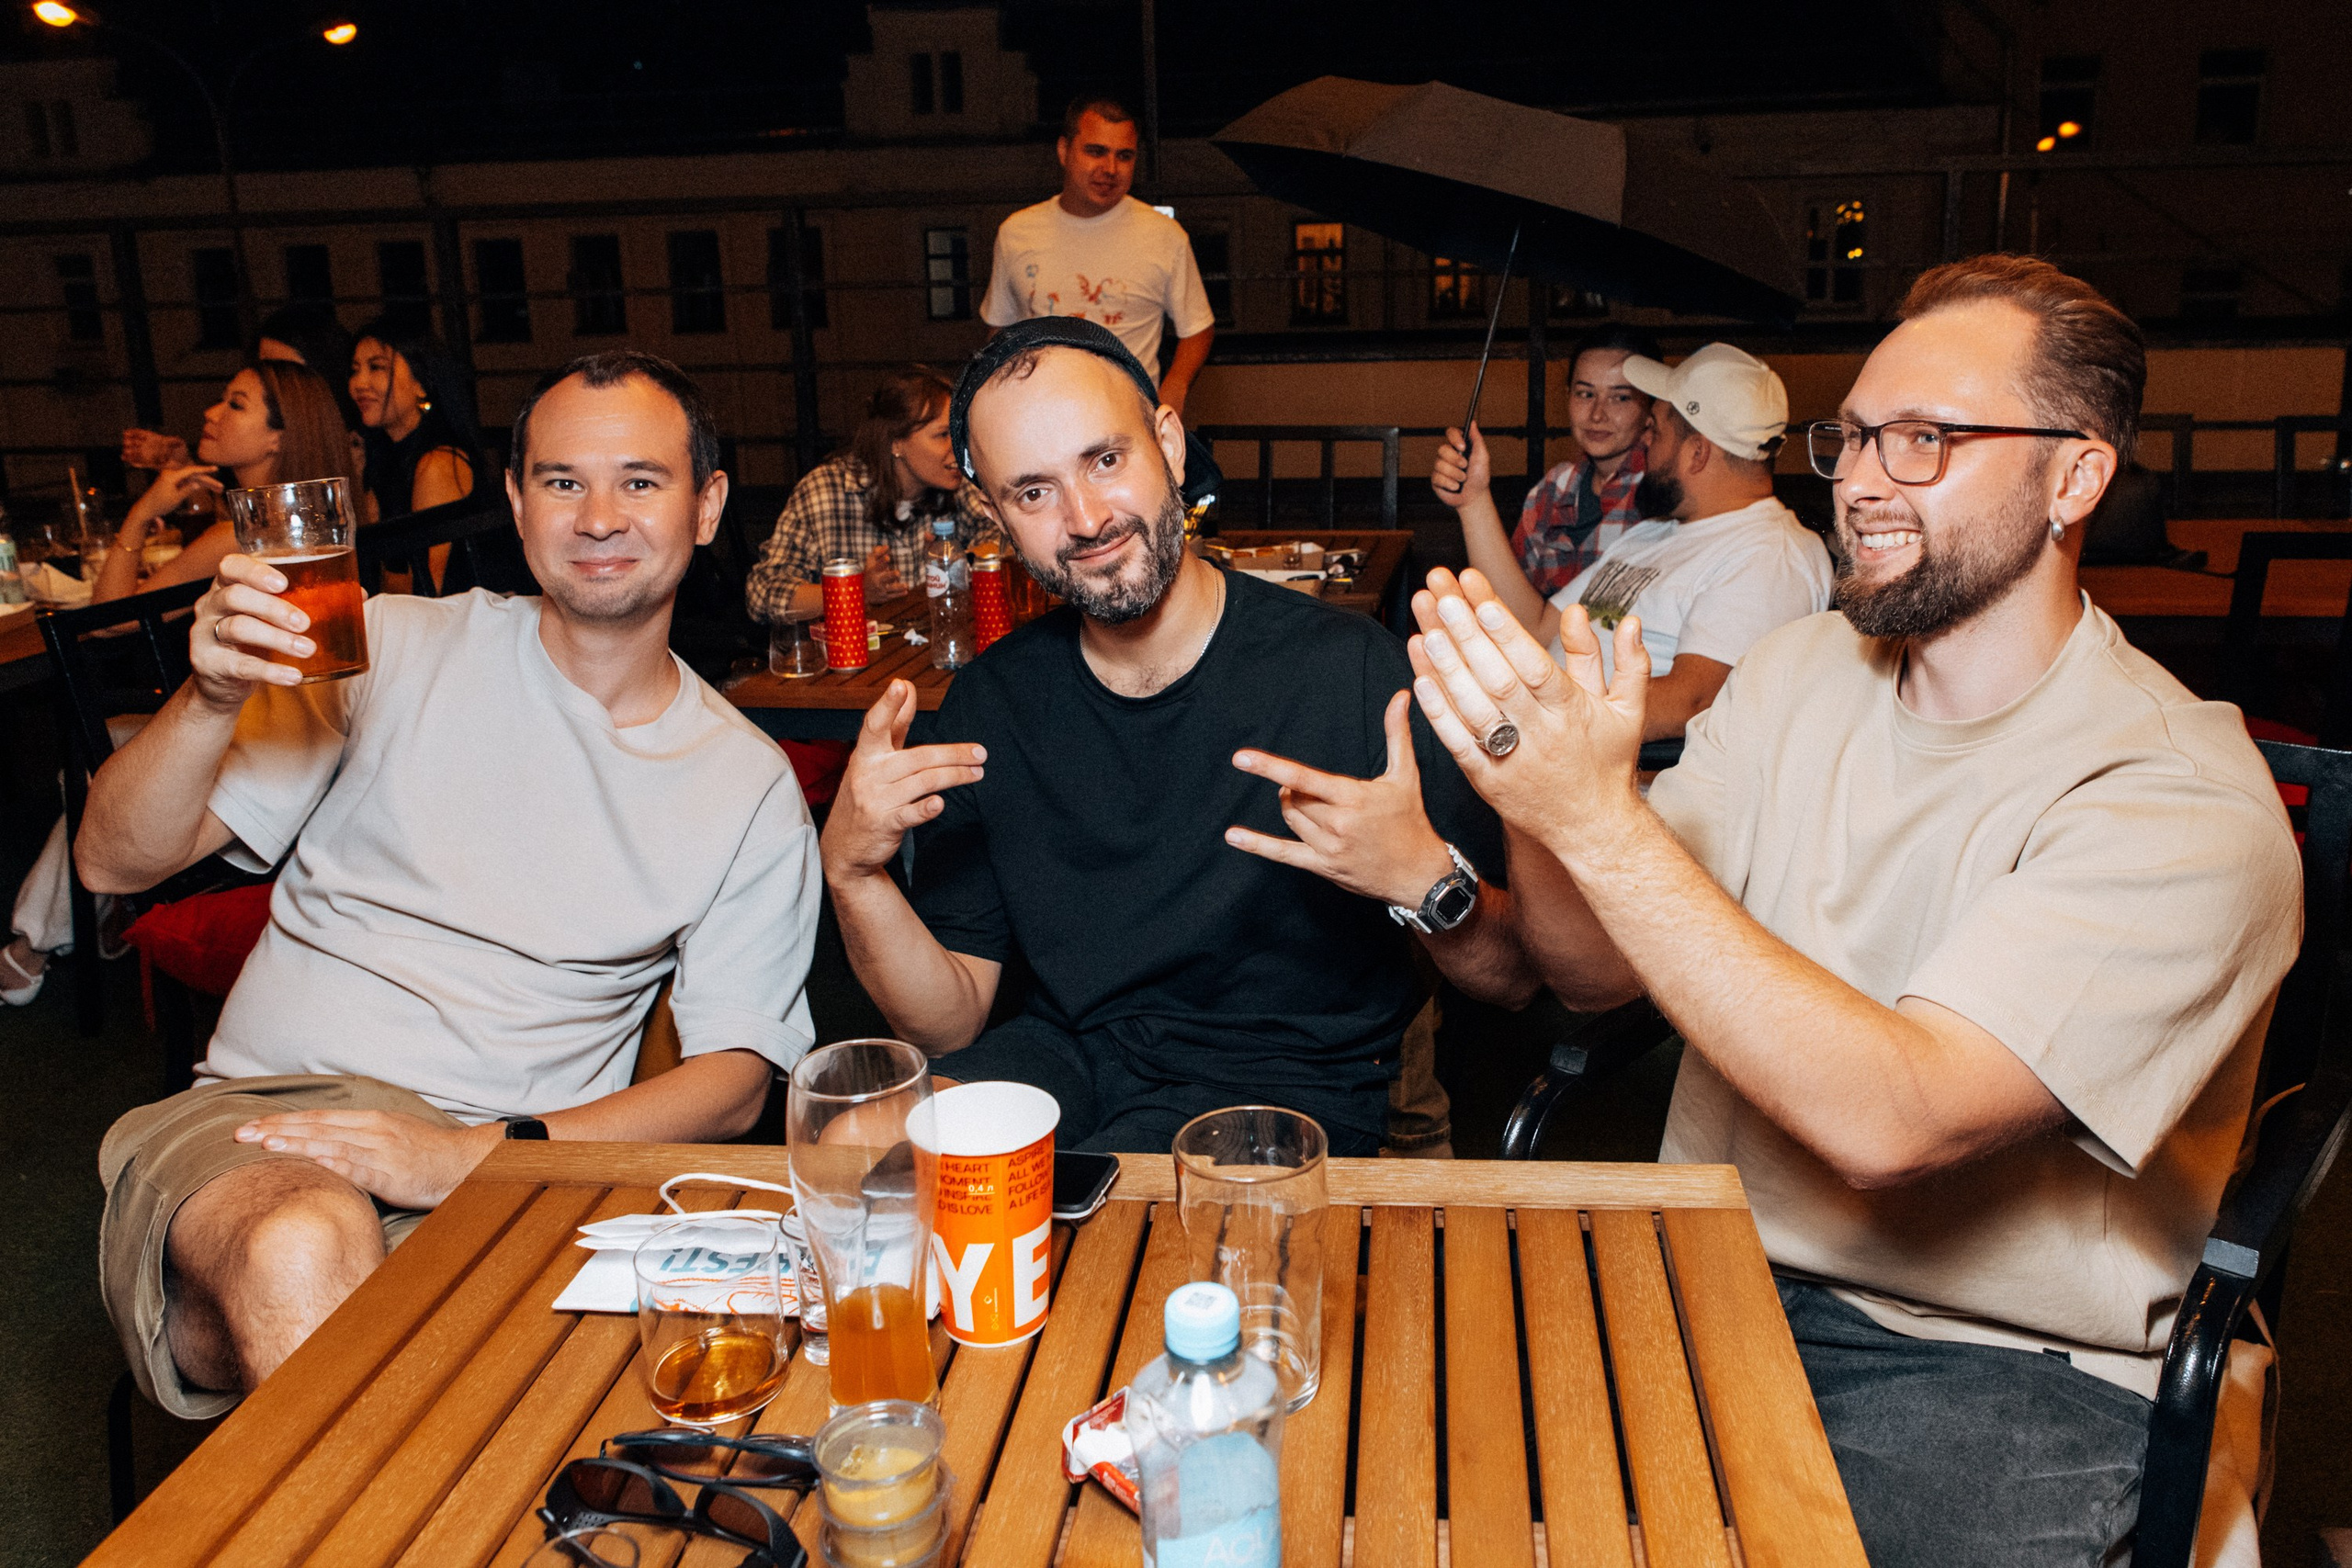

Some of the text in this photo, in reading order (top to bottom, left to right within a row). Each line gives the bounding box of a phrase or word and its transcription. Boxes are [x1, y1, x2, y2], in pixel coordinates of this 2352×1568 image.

[1008, 1145, 1045, 1168] ASPIRE
[945, 1162, 991, 1174] HEART
[1008, 1168, 1029, 1182] ALL
[1031, 1156, 1046, 1173] WE
[968, 1184, 984, 1194] 0,4
[947, 1201, 958, 1213] IS
[960, 1203, 993, 1215] LOVE
[1009, 1199, 1017, 1210] A
[1019, 1190, 1040, 1208] LIFE
